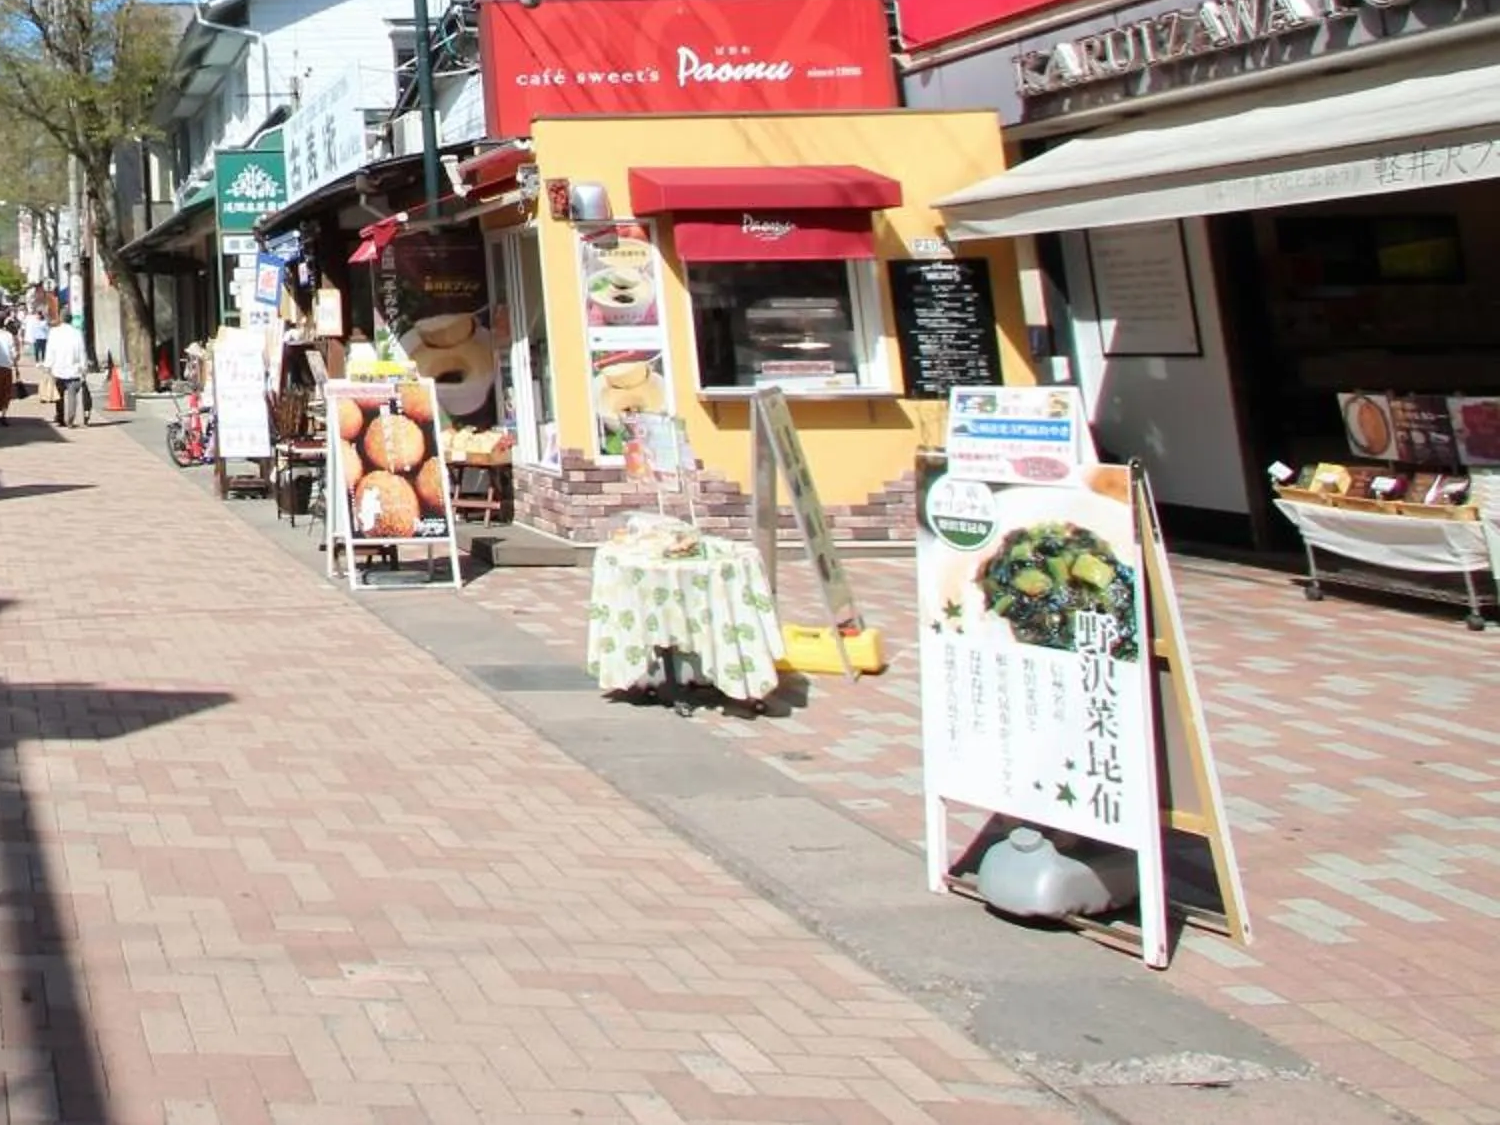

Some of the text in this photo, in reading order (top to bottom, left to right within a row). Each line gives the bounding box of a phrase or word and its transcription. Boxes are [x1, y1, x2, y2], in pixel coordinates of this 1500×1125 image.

[515, 66, 566, 87] café
[1076, 611, 1123, 826] 野沢菜昆布
